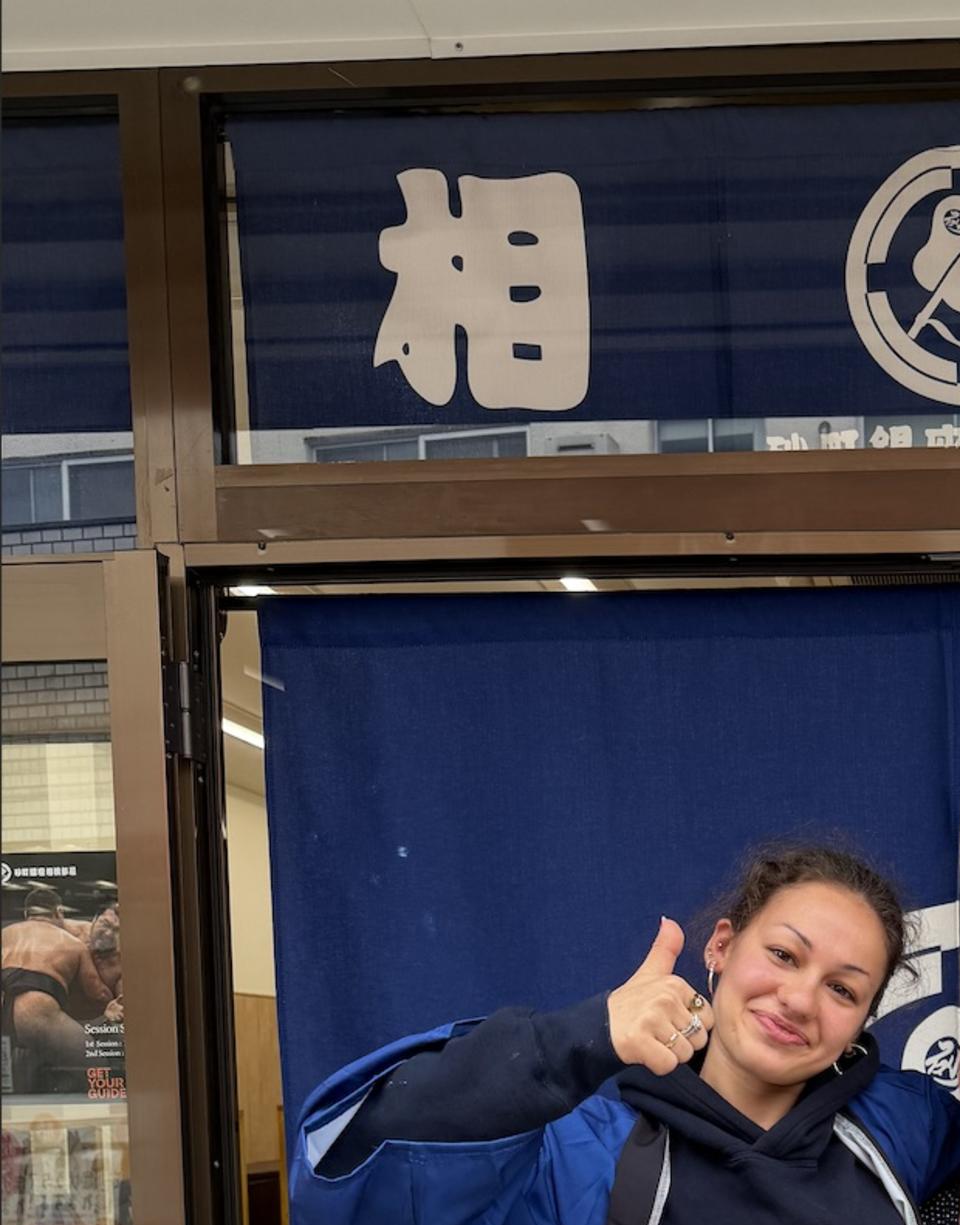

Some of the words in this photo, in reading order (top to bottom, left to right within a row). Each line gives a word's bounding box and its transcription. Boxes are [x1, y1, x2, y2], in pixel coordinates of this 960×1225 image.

[373, 168, 591, 411] 相
[84, 1023, 119, 1034] Session
[87, 1067, 112, 1079] GET
[88, 1077, 124, 1089] YOUR
[88, 1087, 127, 1099] GUIDE
